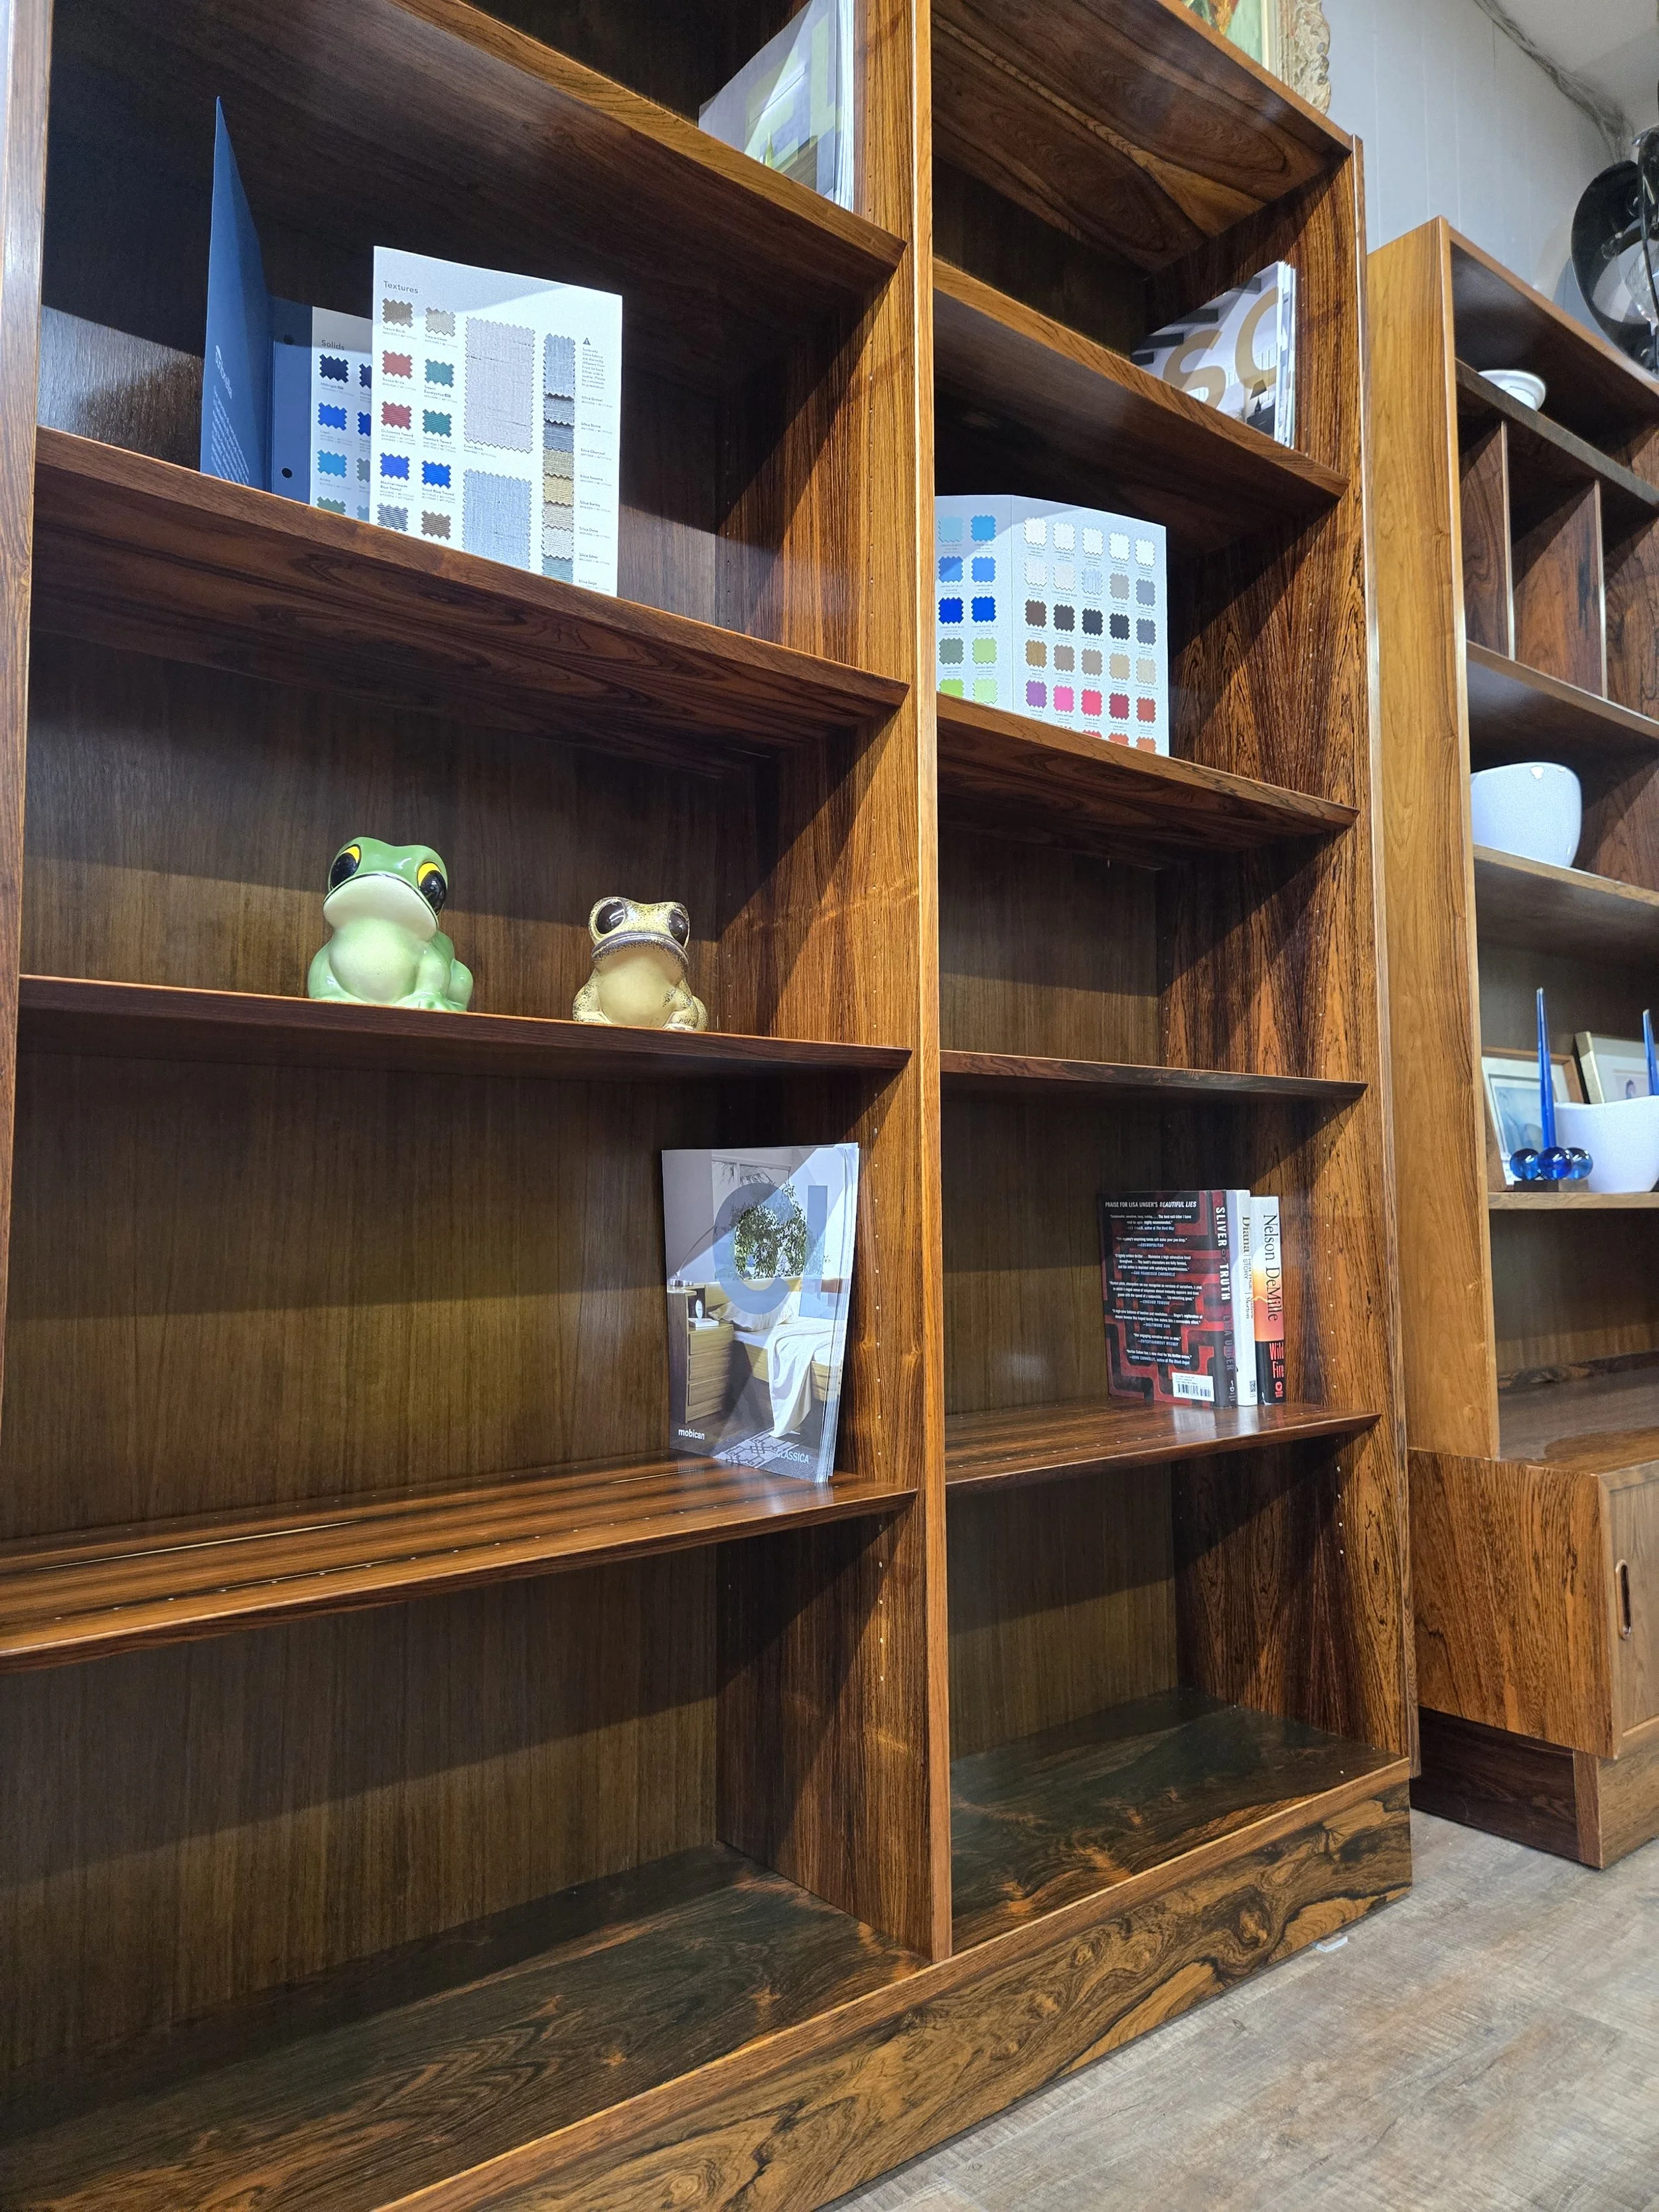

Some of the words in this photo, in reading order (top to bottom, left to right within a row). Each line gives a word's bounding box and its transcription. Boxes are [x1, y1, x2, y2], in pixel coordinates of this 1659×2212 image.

[383, 280, 419, 294] Textures
[321, 339, 345, 350] Solids
[1216, 1207, 1228, 1247] SLIVER
[1242, 1216, 1251, 1254] Diana
[1263, 1213, 1279, 1261] Nelson
[1219, 1262, 1231, 1301] TRUTH
[1265, 1266, 1282, 1322] DeMille
[1224, 1315, 1232, 1336] LISA
[1224, 1340, 1235, 1370] UNGER
[1269, 1341, 1285, 1361] Wild
[1272, 1361, 1285, 1379] Fire
[678, 1429, 705, 1440] mobican
[776, 1449, 810, 1464] CLASSICA
